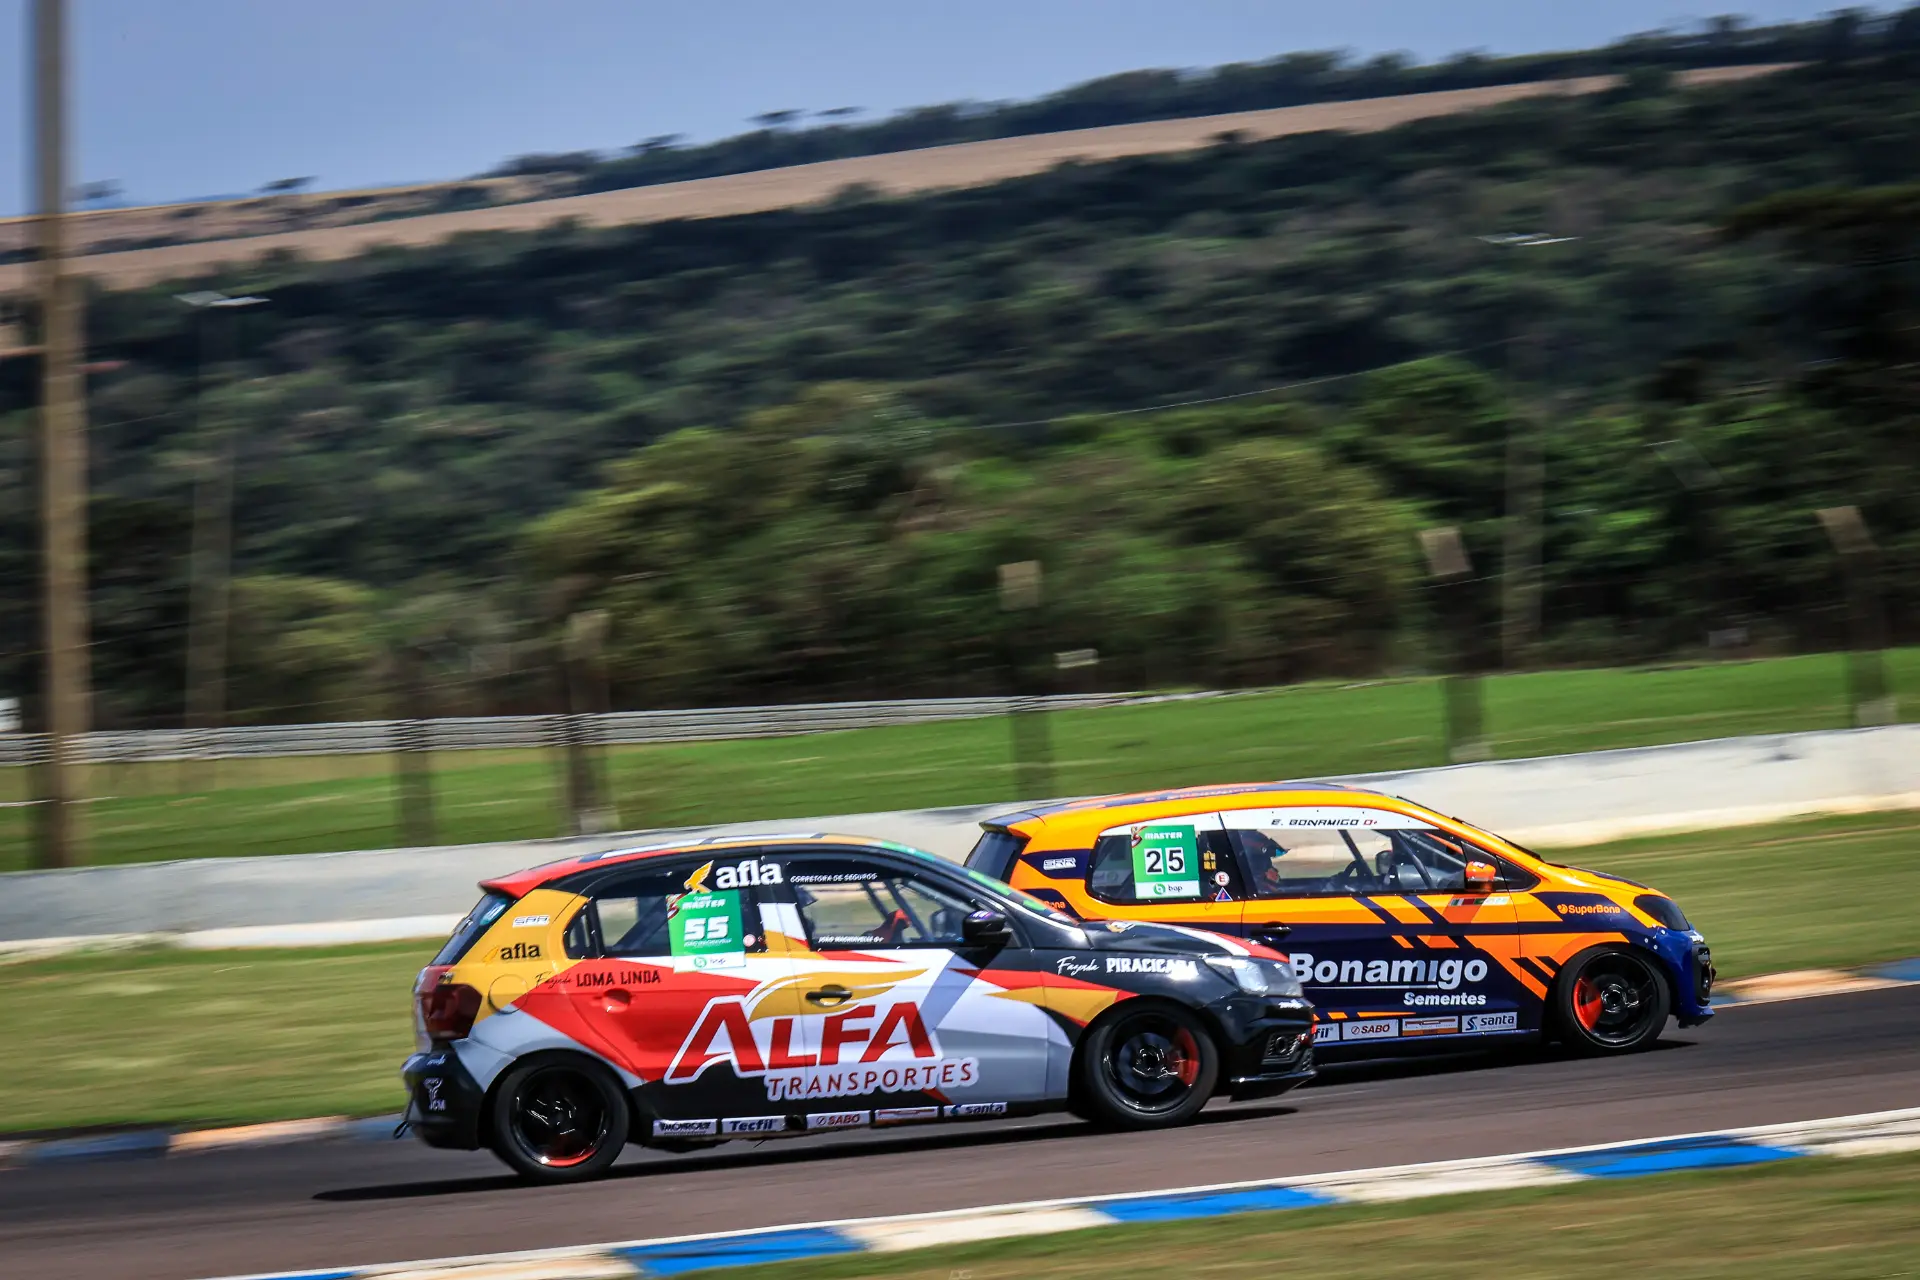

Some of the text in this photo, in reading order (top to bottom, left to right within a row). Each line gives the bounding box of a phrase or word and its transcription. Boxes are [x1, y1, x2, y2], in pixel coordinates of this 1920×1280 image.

[1289, 818, 1359, 826] BONAMIGO
[1144, 831, 1183, 839] MASTER
[1146, 849, 1183, 874] 25
[716, 860, 783, 889] afla
[790, 874, 832, 883] CORRETORA
[844, 872, 878, 880] SEGUROS
[682, 899, 726, 910] MASTER
[1568, 904, 1621, 915] SuperBona
[684, 916, 729, 941] 55
[500, 943, 541, 961] afla
[576, 972, 615, 987] LOMA
[620, 970, 661, 985] LINDA
[1289, 953, 1488, 990] Bonamigo
[1403, 992, 1486, 1006] Sementes
[1479, 1014, 1515, 1027] santa
[669, 1000, 937, 1080] ALFA
[767, 1061, 973, 1098] TRANSPORTES
[966, 1103, 1004, 1115] santa
[730, 1119, 774, 1132] Tecfil
